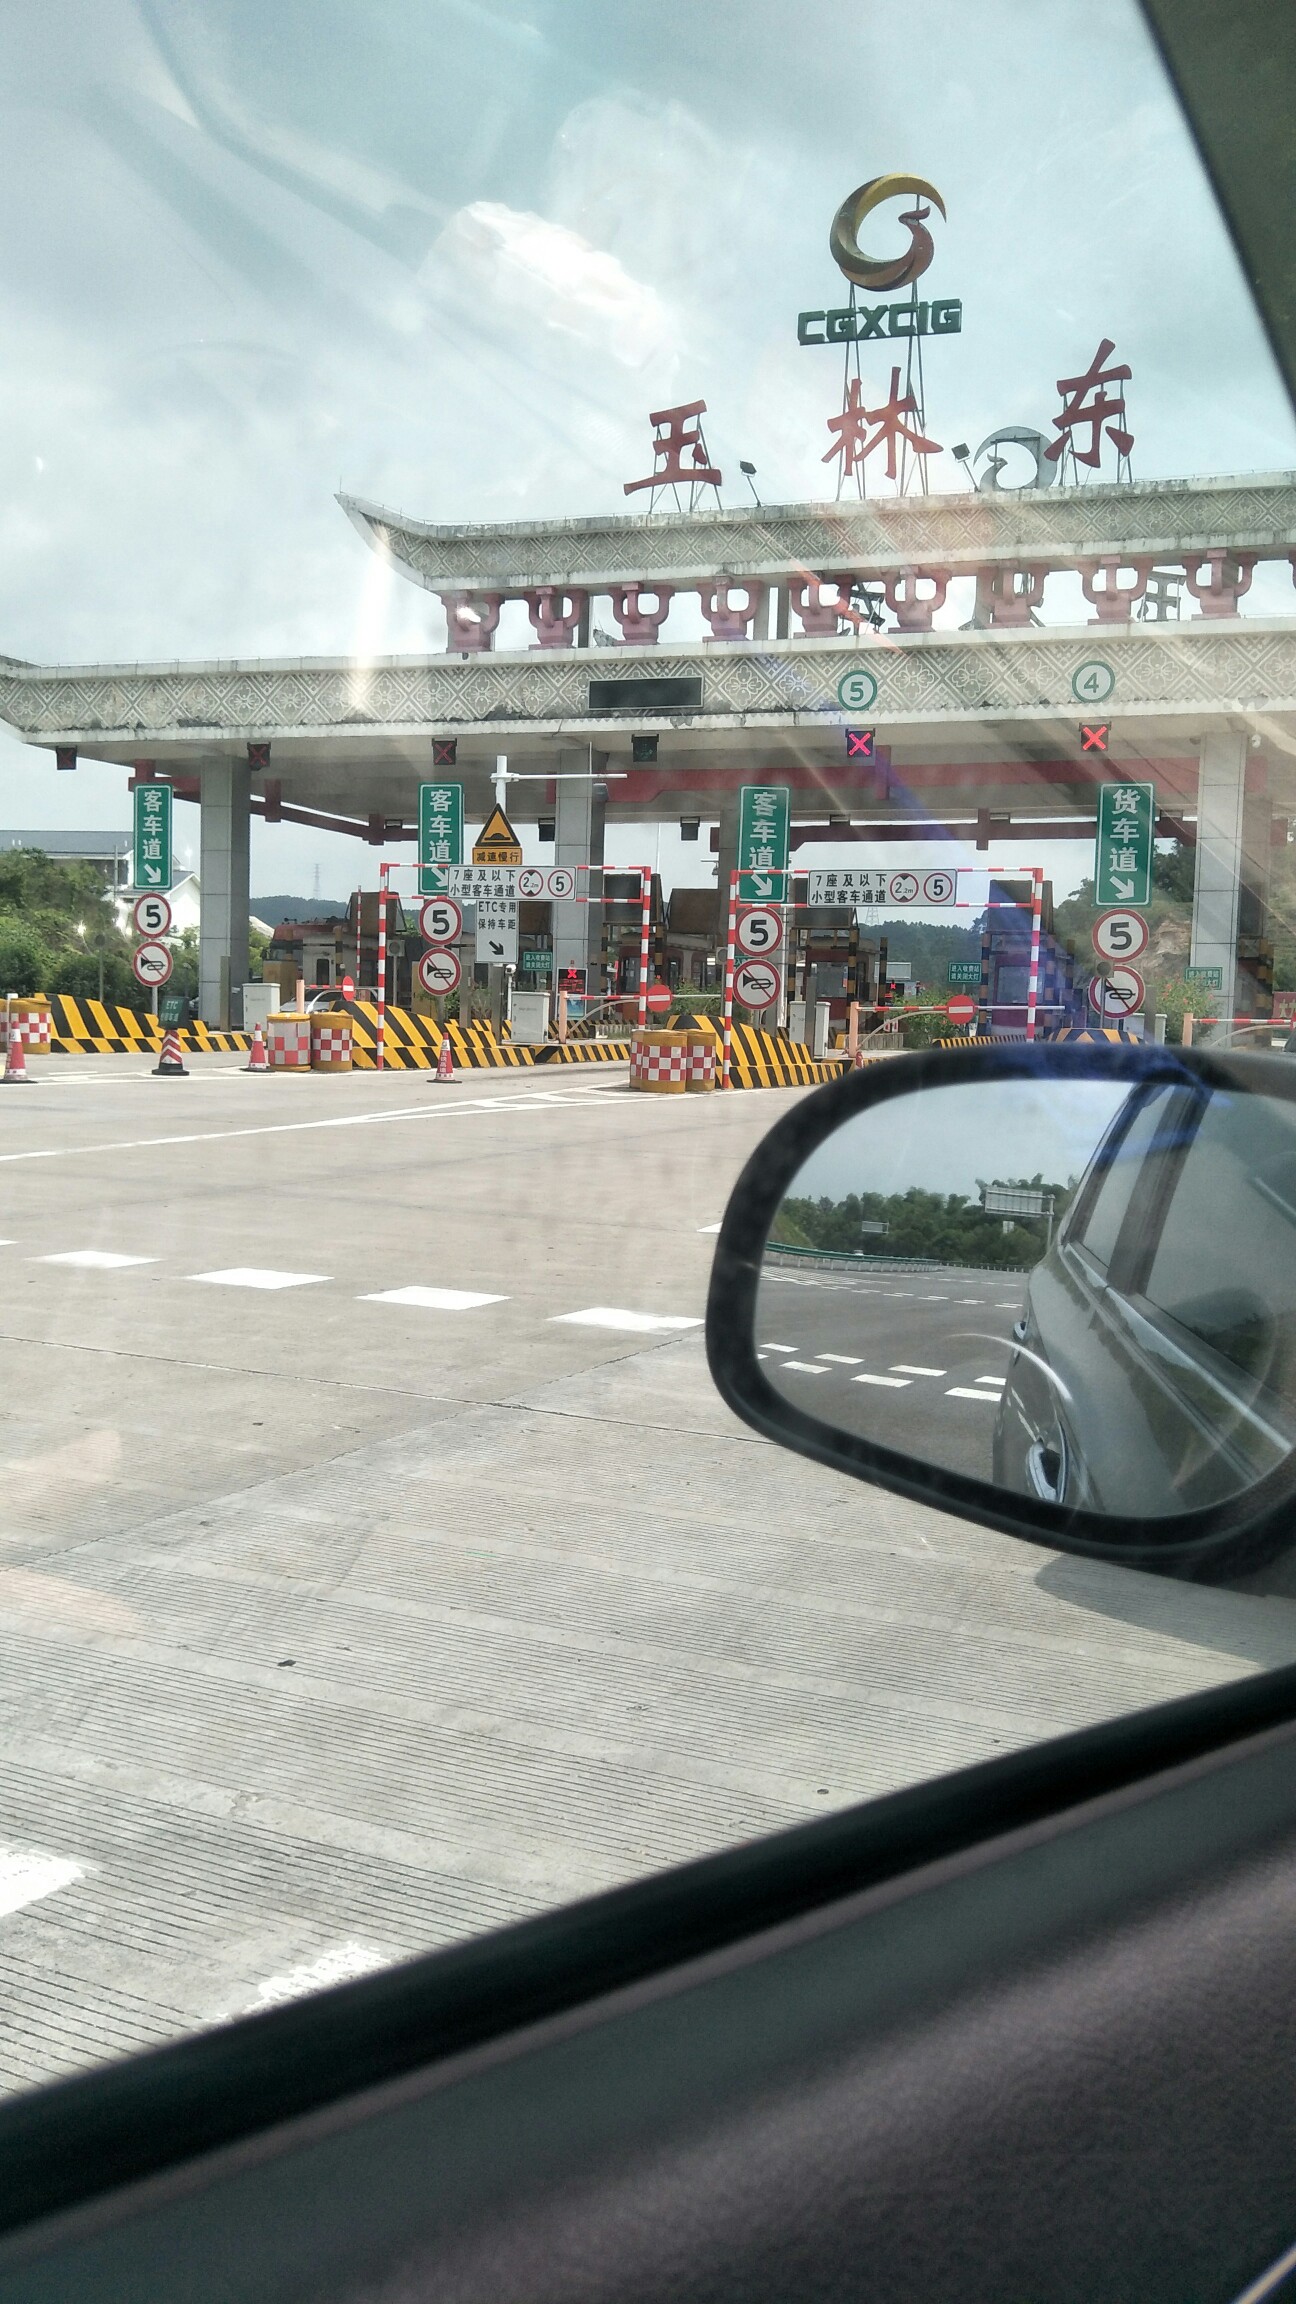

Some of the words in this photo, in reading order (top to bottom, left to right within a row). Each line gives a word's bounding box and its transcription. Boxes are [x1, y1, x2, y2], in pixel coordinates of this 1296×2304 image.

[797, 299, 963, 346] CGXCIG
[624, 338, 1135, 496] 玉林东
[848, 681, 864, 701] 5
[1083, 674, 1100, 691] 4
[142, 790, 164, 860] 客车道
[429, 789, 453, 863] 客车道
[749, 791, 778, 870] 客车道
[1108, 788, 1141, 873] 货车道
[476, 851, 520, 863] 减速慢行
[453, 869, 516, 882] 7座及以下
[555, 876, 565, 892] 5
[815, 873, 887, 887] 7座及以下
[450, 884, 516, 898] 小型客车通道
[811, 890, 887, 904] 小型客车通道
[894, 881, 914, 894] 2.2m
[933, 879, 944, 896] 5
[146, 904, 162, 928] 5
[432, 909, 450, 935] 5
[478, 919, 516, 930] 保持车距
[749, 919, 769, 946] 5
[1109, 921, 1133, 951] 5
